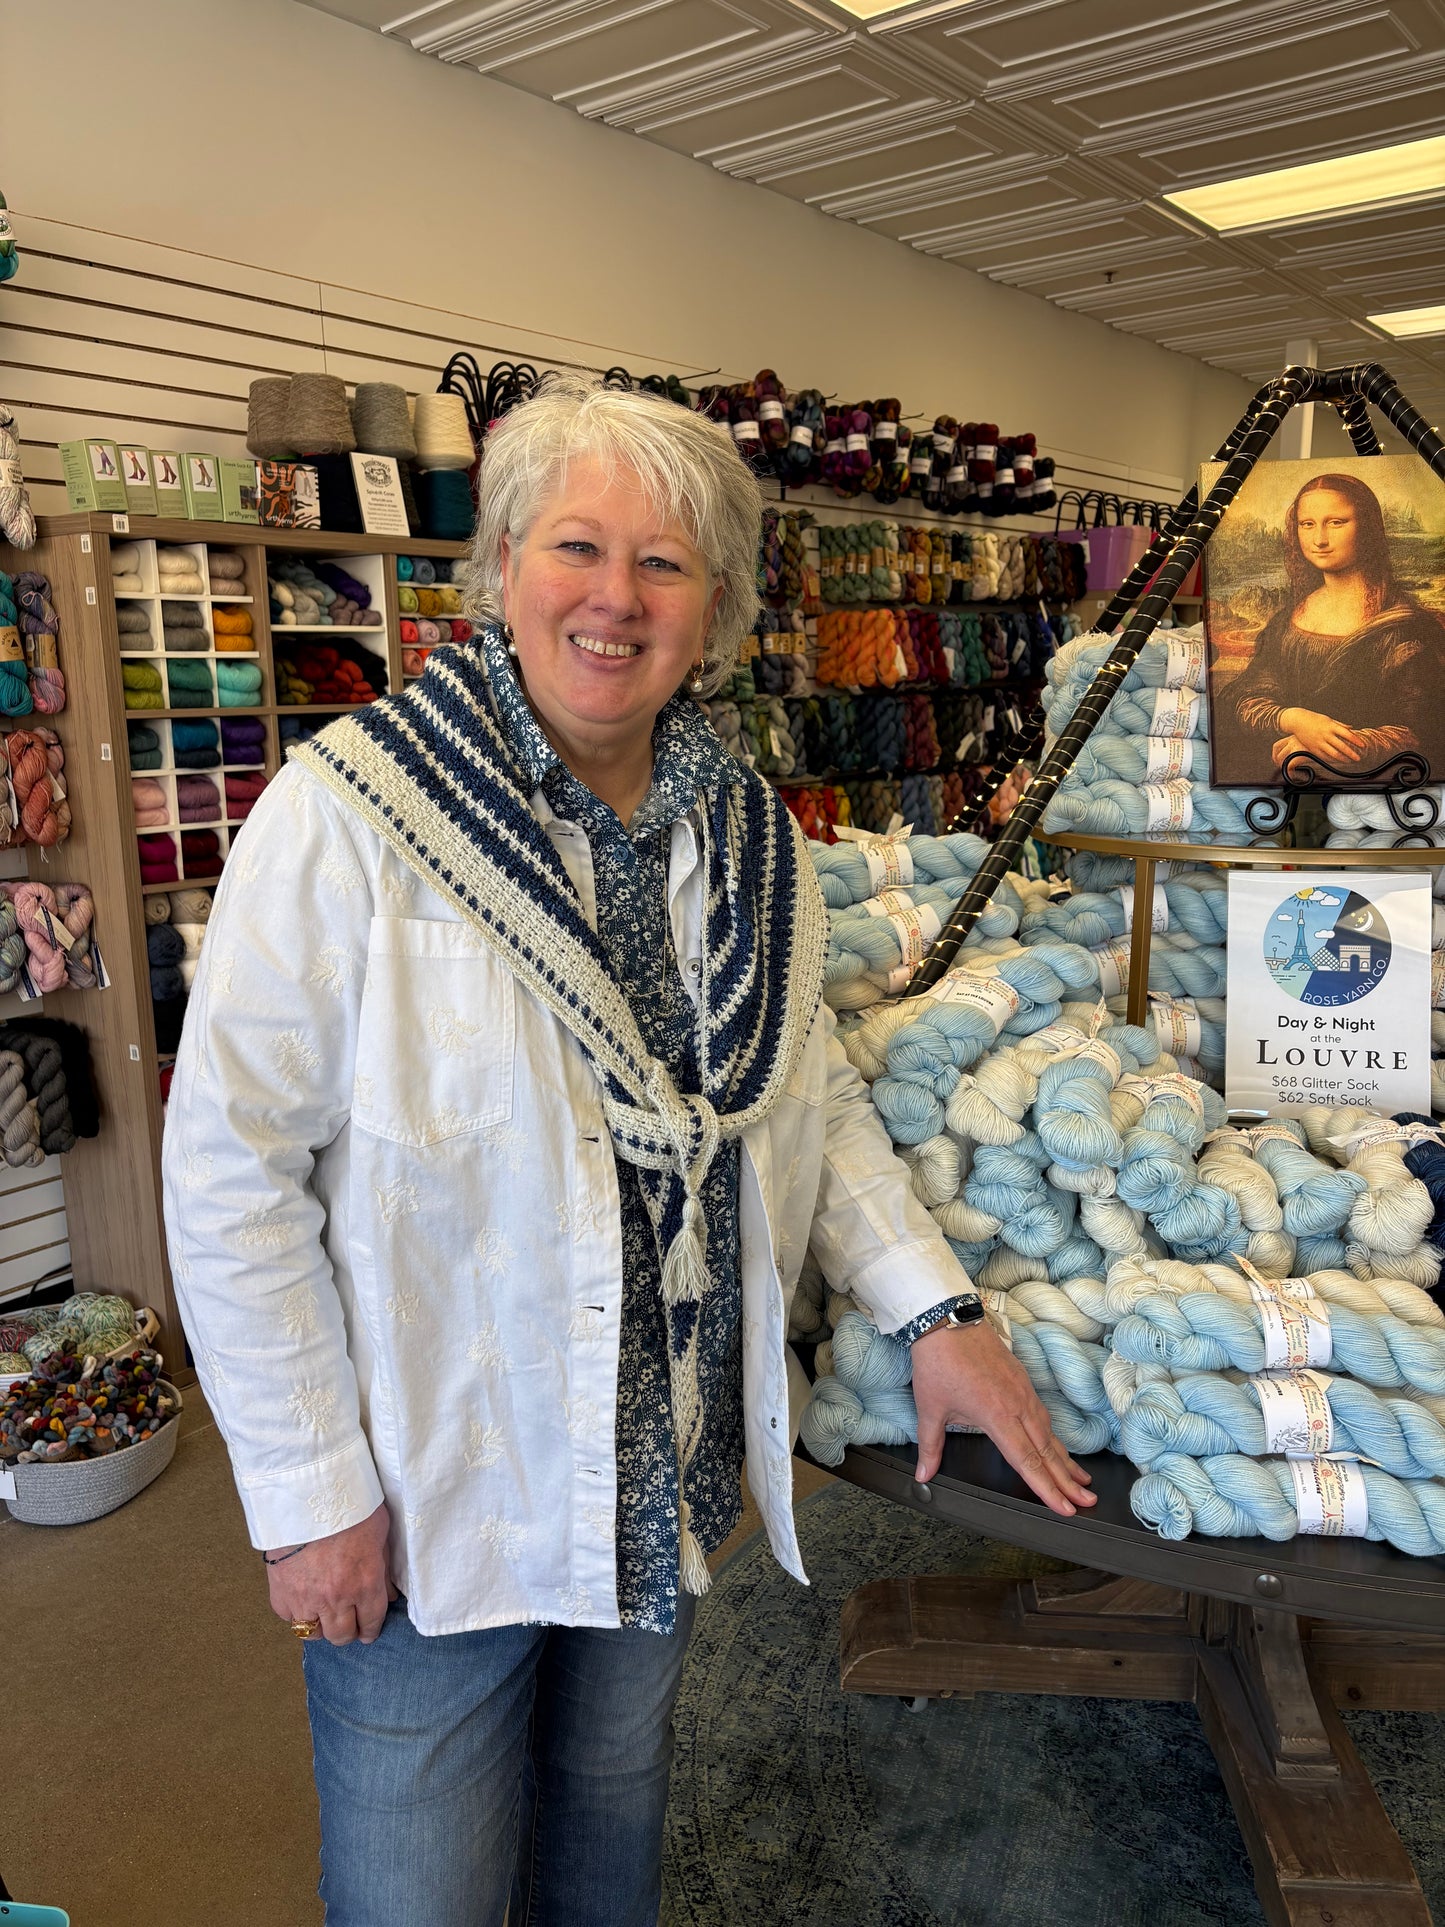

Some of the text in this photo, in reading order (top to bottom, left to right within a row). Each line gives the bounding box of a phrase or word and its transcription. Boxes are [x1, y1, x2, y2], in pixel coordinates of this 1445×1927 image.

[1303, 956, 1390, 1006] ROSE YARN CO.
[1278, 1016, 1376, 1033] Day & Night
[1310, 1034, 1342, 1044] at the
[1256, 1039, 1408, 1070] LOUVRE
[1272, 1076, 1380, 1092] $68 Glitter Sock
[1278, 1092, 1372, 1107] $62 Soft Sock
